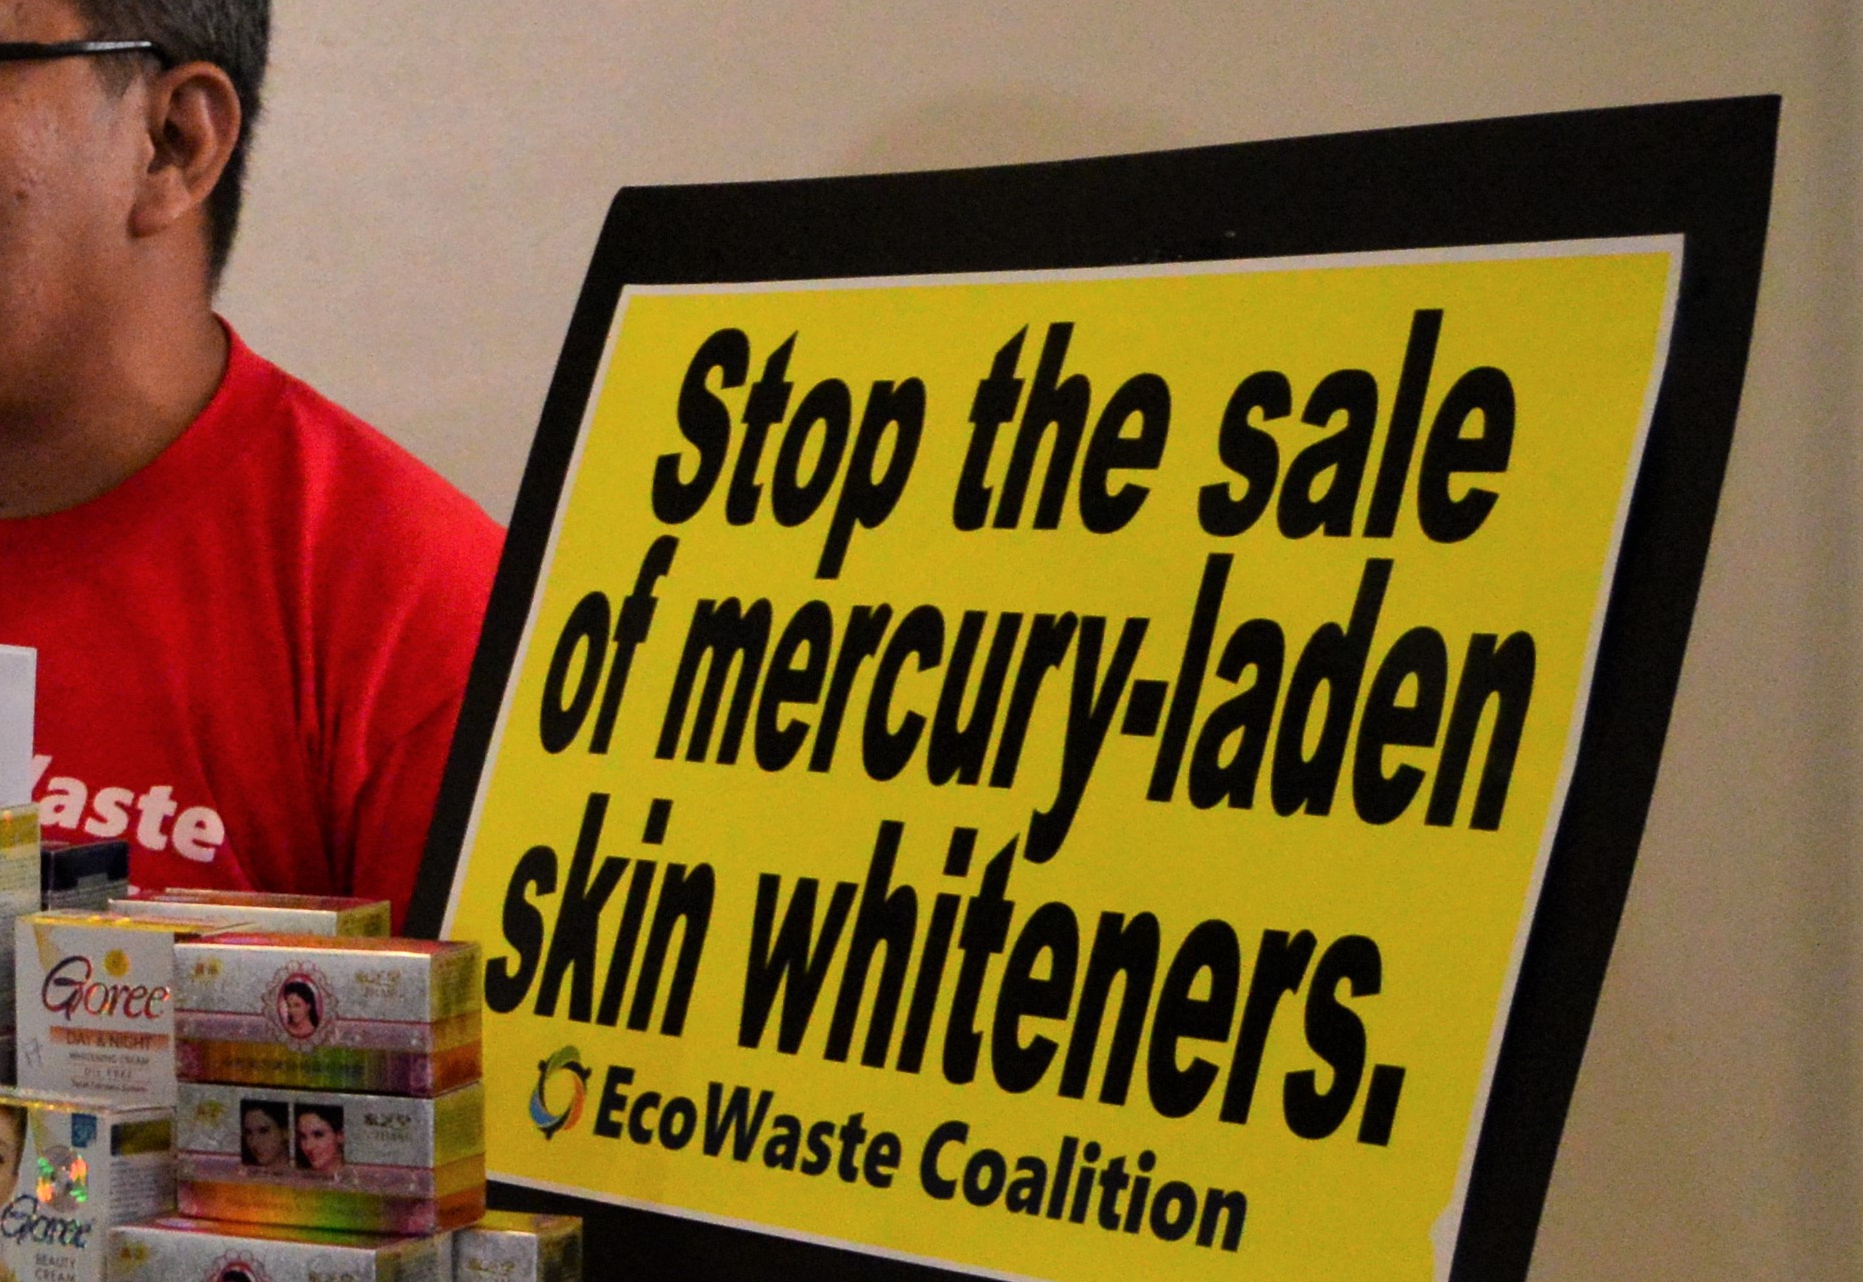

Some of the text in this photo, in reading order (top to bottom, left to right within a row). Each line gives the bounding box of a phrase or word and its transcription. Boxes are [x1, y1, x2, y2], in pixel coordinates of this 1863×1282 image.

[653, 310, 1515, 578] Stop the sale
[541, 536, 1535, 863] of mercury-laden
[42, 955, 170, 1021] Goree
[485, 794, 1405, 1146] skin whiteners.
[594, 1066, 1246, 1251] EcoWaste Coalition
